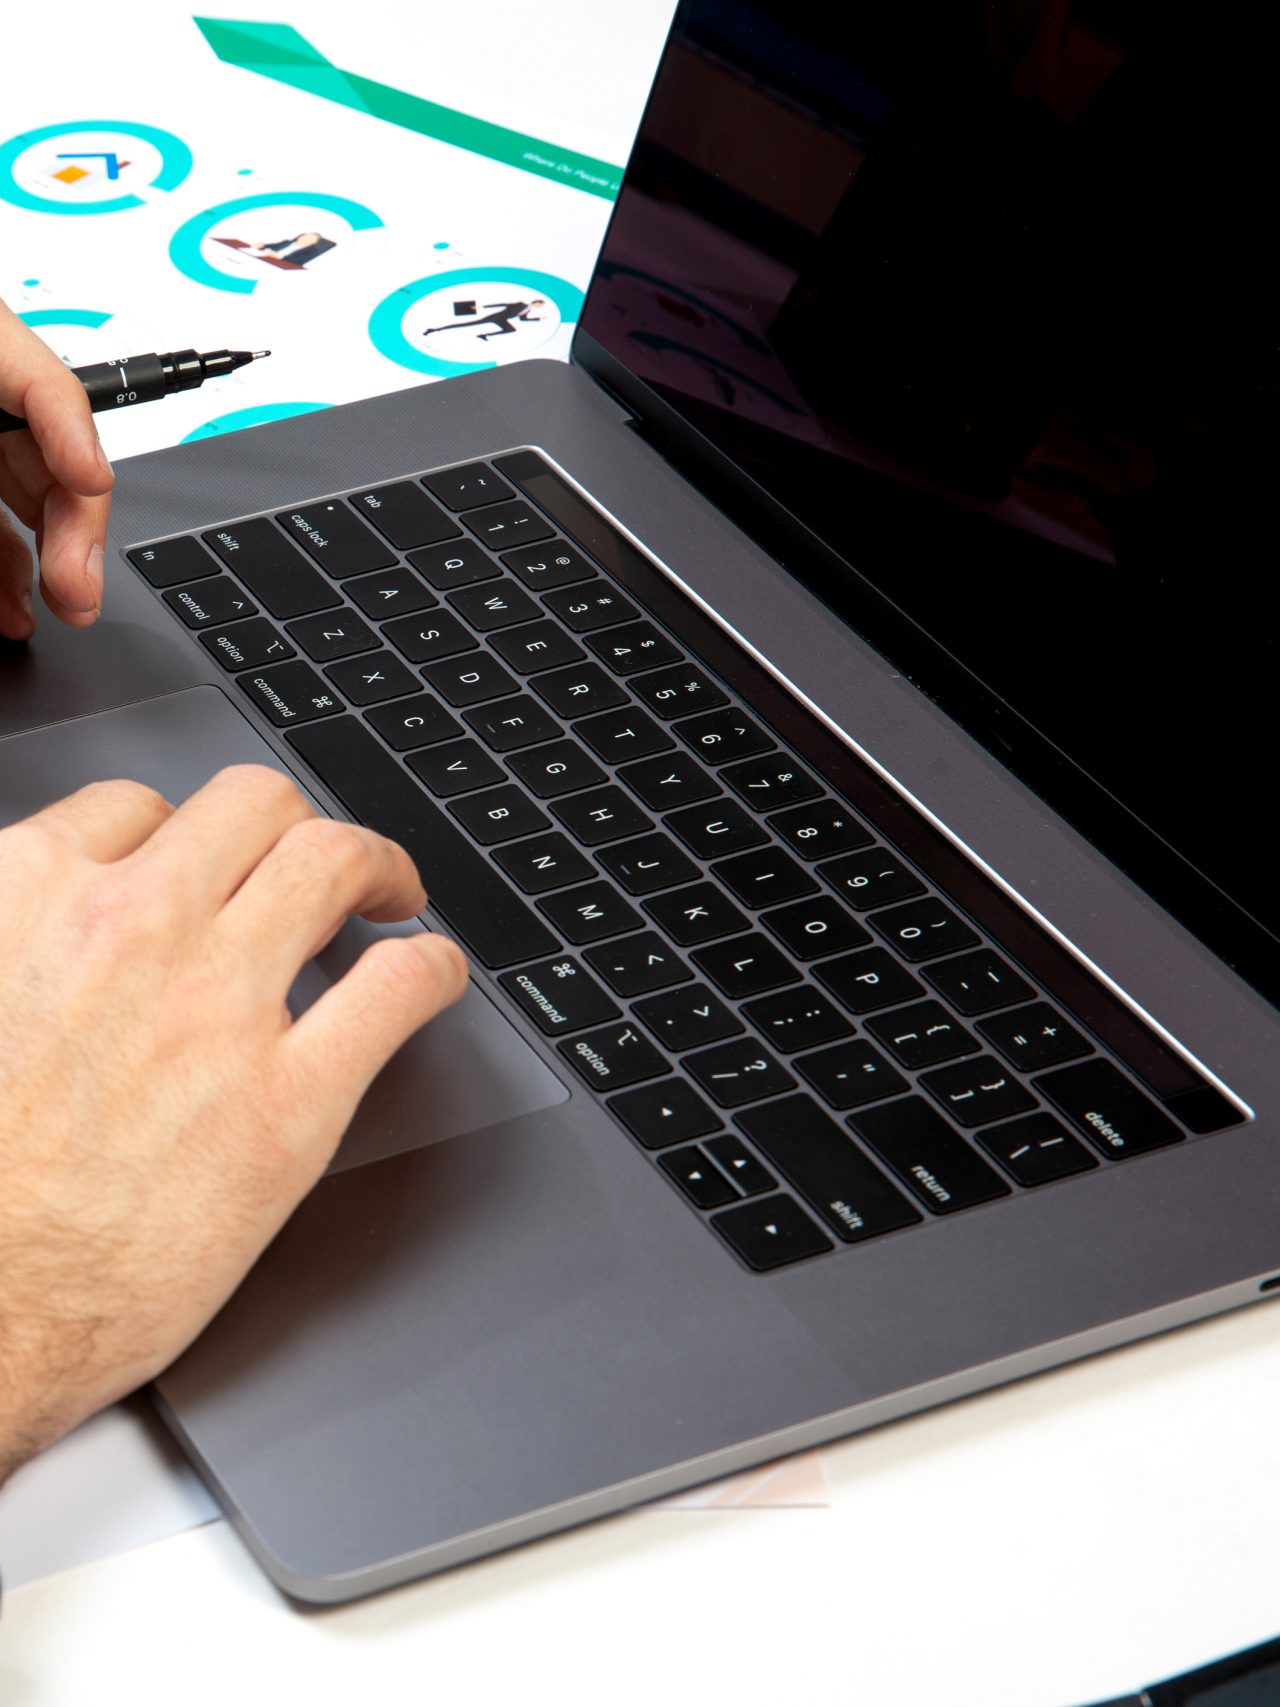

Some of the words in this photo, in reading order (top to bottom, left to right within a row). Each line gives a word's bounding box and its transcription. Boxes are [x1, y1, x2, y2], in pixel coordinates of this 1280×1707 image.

[117, 392, 137, 404] 0.8
[364, 495, 382, 508] tab
[291, 513, 313, 533] caps
[307, 530, 328, 549] lock
[489, 523, 504, 531] 1
[217, 532, 240, 552] shift
[142, 550, 155, 561] fn
[445, 559, 463, 569] Q
[527, 564, 546, 572] 2
[379, 590, 398, 599] A
[178, 591, 210, 620] control
[484, 597, 507, 609] W
[569, 604, 588, 612] 3
[323, 629, 344, 639] Z
[420, 630, 439, 639] S
[217, 636, 245, 663] option
[526, 642, 547, 651] E
[614, 647, 631, 655] 4
[362, 672, 384, 683] X
[459, 673, 479, 683] D
[569, 685, 589, 695] R
[656, 690, 676, 699] 5
[253, 677, 297, 718] command
[404, 717, 424, 727] C
[502, 717, 523, 725] F
[615, 729, 635, 738] T
[702, 735, 721, 744] 6
[447, 761, 467, 770] V
[546, 763, 566, 773] G
[660, 774, 681, 783] Y
[749, 779, 770, 787] 7
[488, 808, 509, 819] B
[590, 809, 613, 821] H
[706, 822, 728, 833] U
[797, 828, 818, 838] 8
[532, 856, 556, 869] N
[848, 877, 868, 887] 9
[578, 905, 603, 919] M
[684, 907, 708, 920] K
[734, 959, 753, 971] L
[856, 973, 879, 983] P
[516, 974, 567, 1023] command
[575, 1042, 610, 1076] option
[1084, 1111, 1124, 1147] delete
[912, 1165, 950, 1202] return
[830, 1201, 863, 1230] shift
